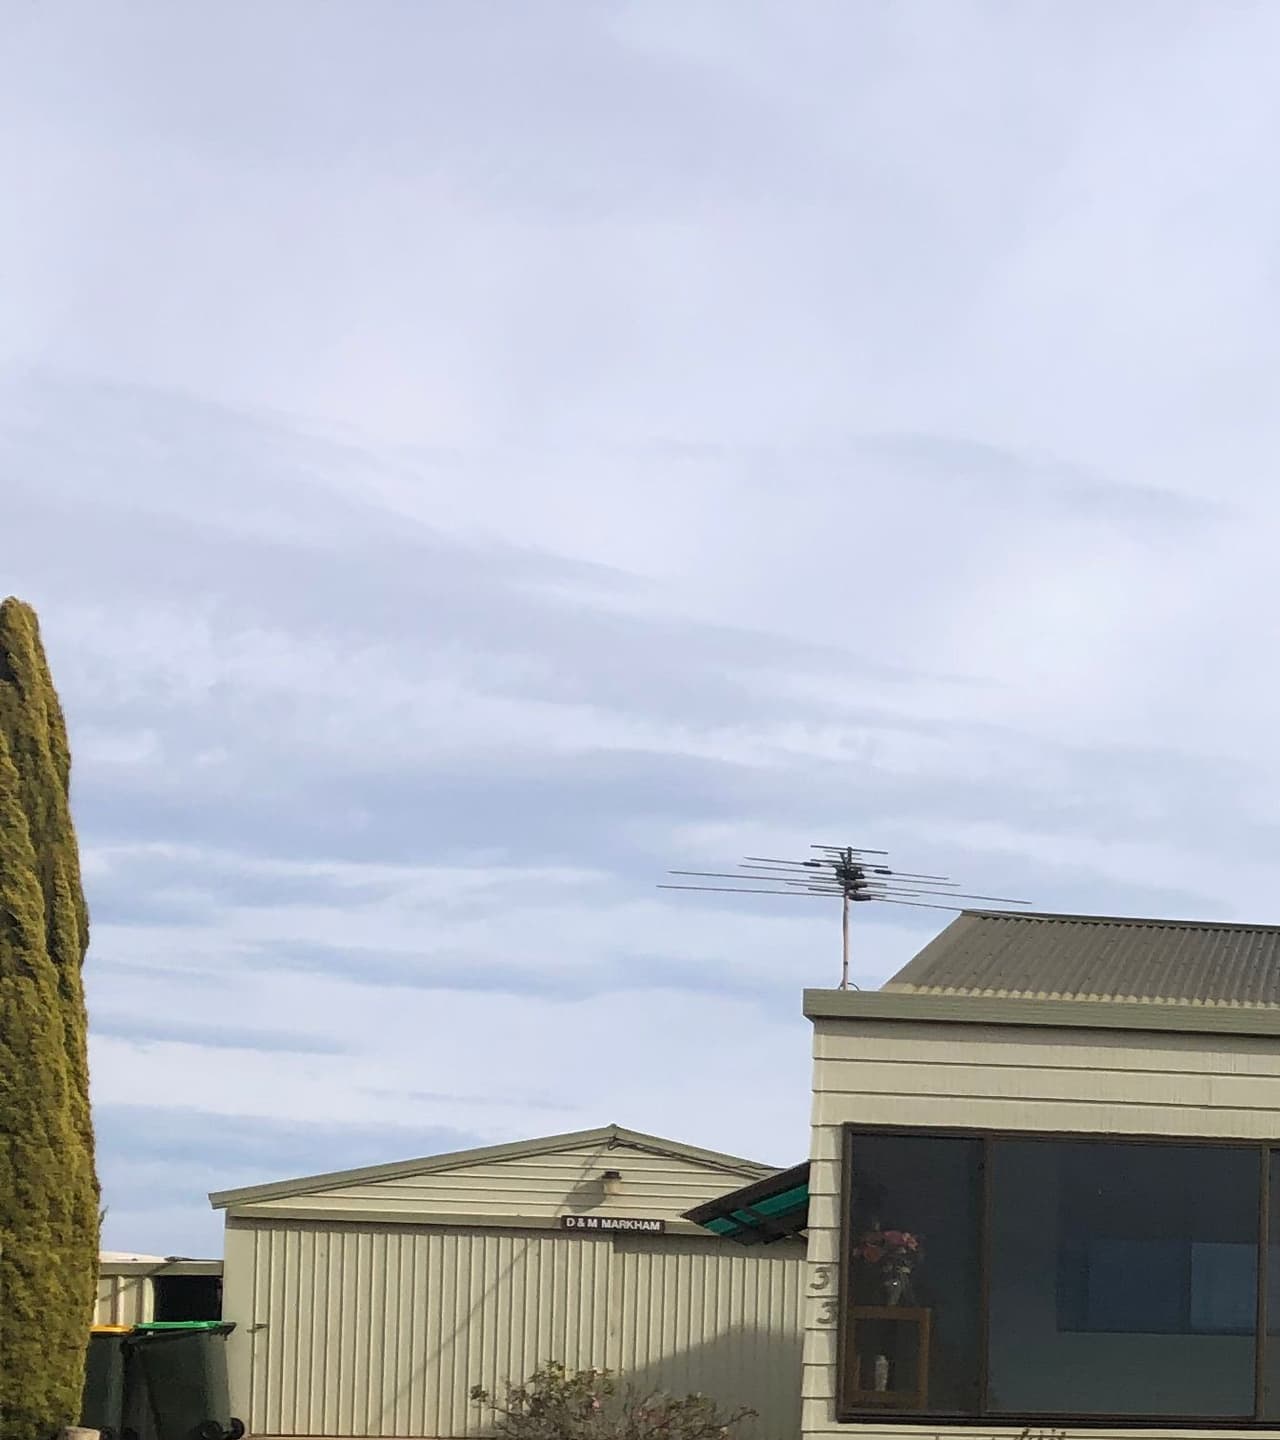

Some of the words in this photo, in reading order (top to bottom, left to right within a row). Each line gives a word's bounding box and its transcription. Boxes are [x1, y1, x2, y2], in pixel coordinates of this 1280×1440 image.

[566, 1217, 576, 1227] D
[577, 1217, 586, 1227] &
[587, 1218, 598, 1228] M
[601, 1219, 661, 1231] MARKHAM
